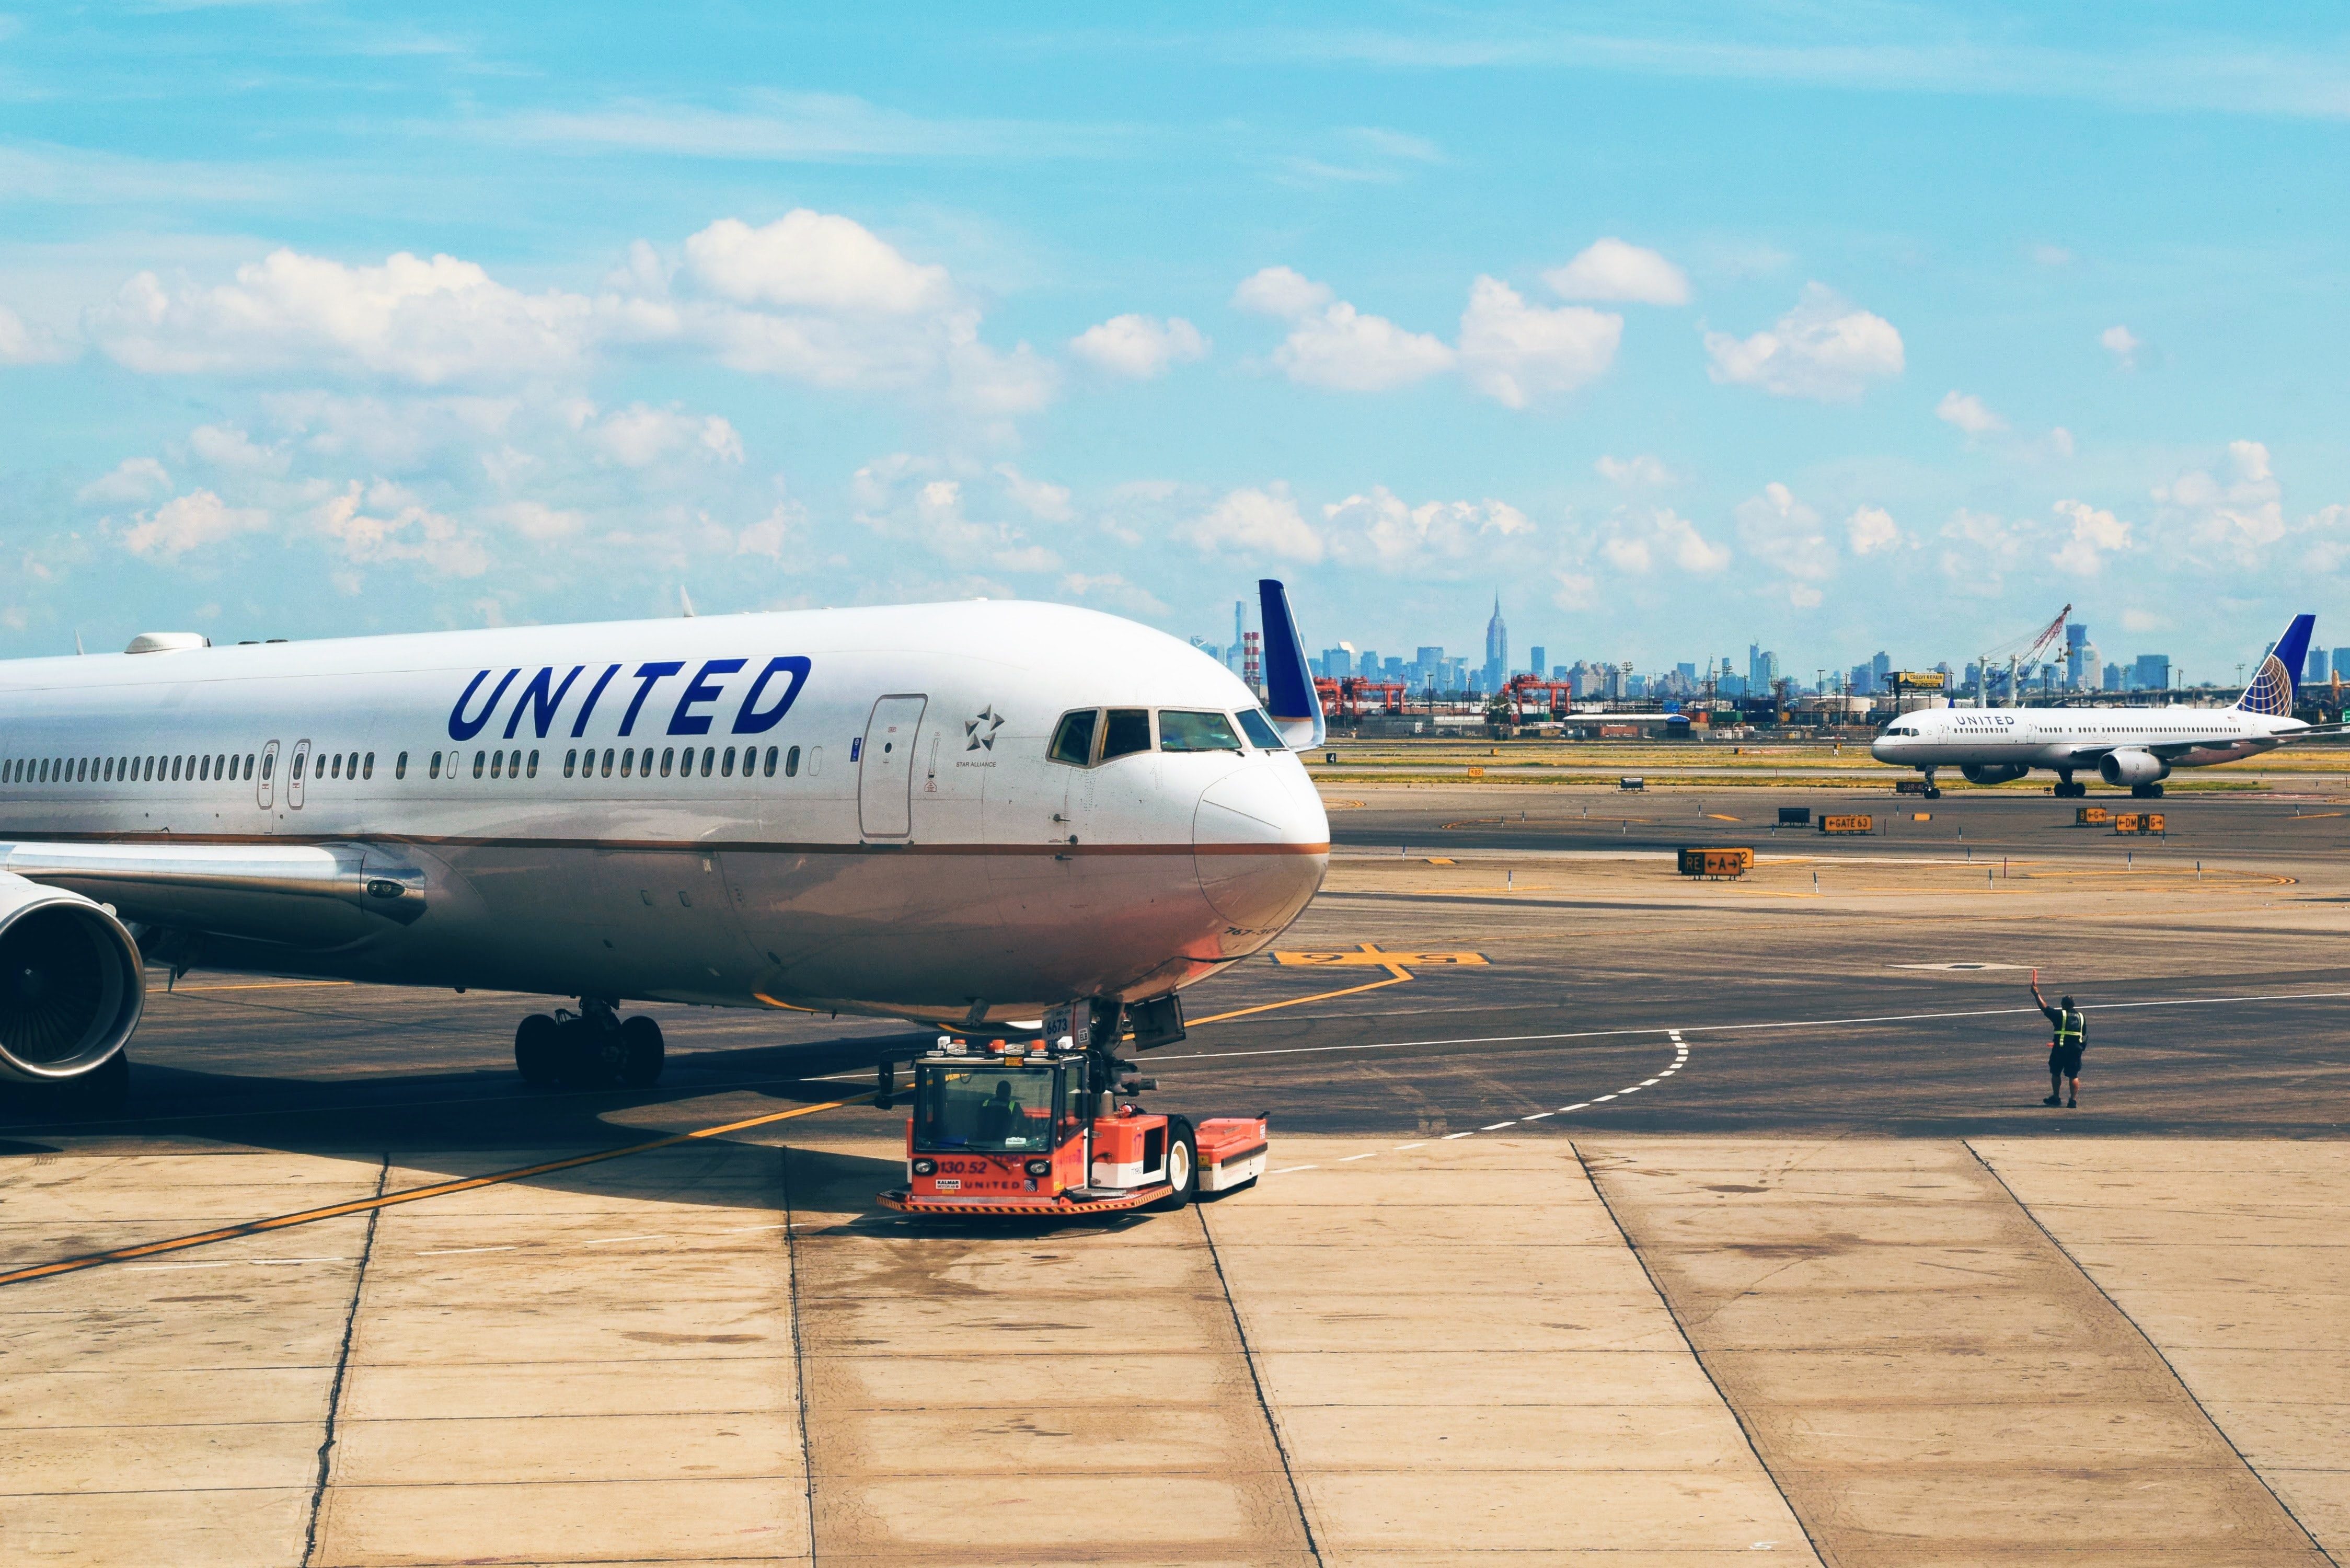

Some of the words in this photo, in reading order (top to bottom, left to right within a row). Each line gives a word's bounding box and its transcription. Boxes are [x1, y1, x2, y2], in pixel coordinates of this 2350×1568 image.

[448, 656, 812, 741] UNITED
[1955, 716, 2014, 725] UNITED
[1330, 754, 1334, 763] 4
[2080, 811, 2084, 820] B
[1836, 819, 1855, 827] GATE
[1858, 818, 1867, 827] 63
[2126, 818, 2136, 827] DM
[2141, 818, 2146, 827] A
[2151, 818, 2155, 827] G
[1686, 857, 1700, 870] RE
[1719, 858, 1726, 870] A
[1047, 1018, 1067, 1034] 6673
[941, 1161, 987, 1174] 130.52
